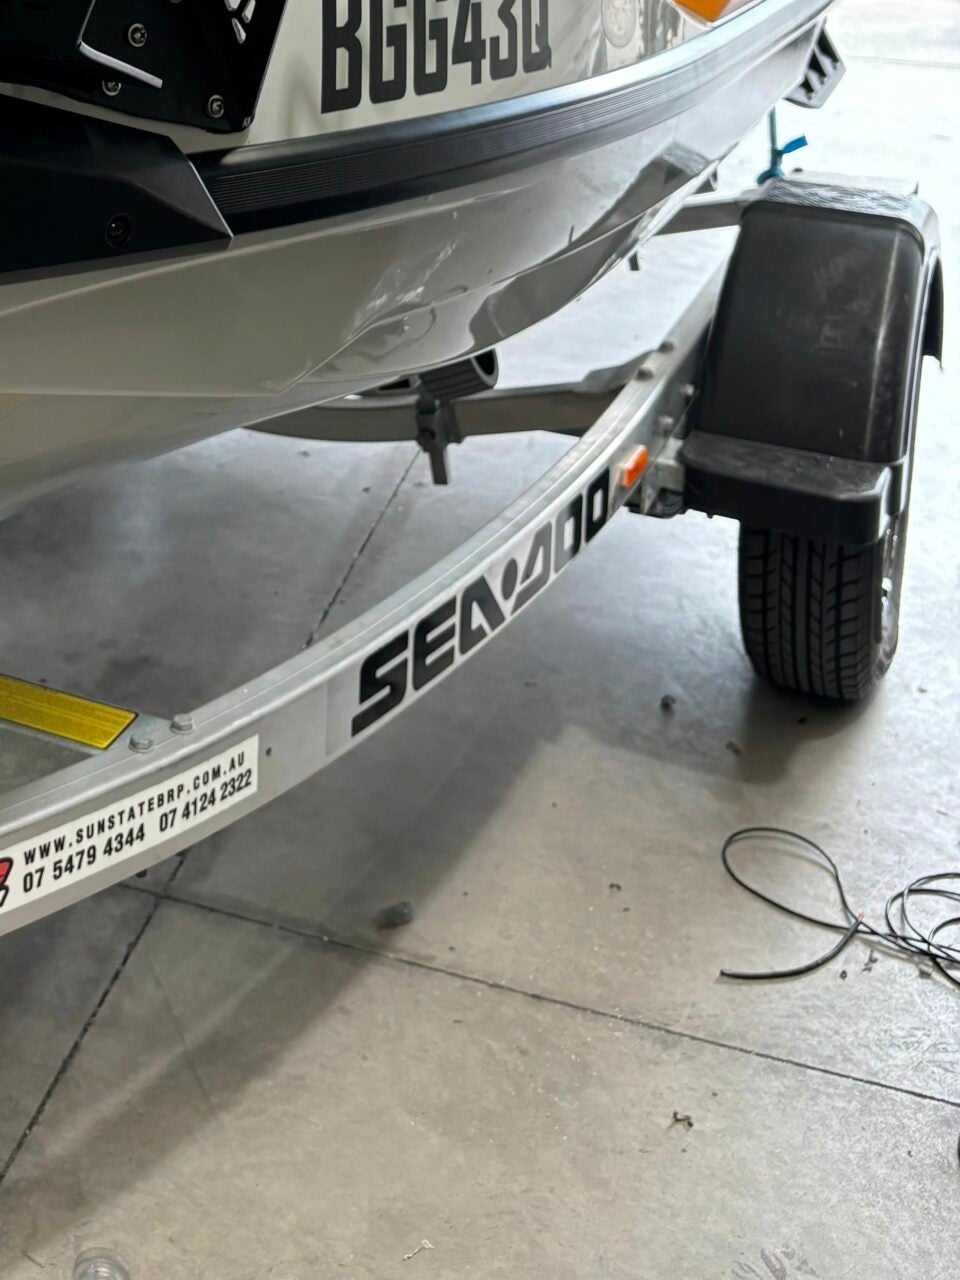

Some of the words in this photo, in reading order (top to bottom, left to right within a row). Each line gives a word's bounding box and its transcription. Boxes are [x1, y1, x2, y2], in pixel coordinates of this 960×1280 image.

[23, 869, 45, 893] 07
[53, 845, 97, 880] 5479
[103, 822, 145, 857] 4344
[159, 808, 179, 832] 07
[181, 788, 216, 820] 4124
[220, 768, 252, 802] 2322
[24, 751, 246, 866] WWW.SUNSTATEBRP.COM.AU
